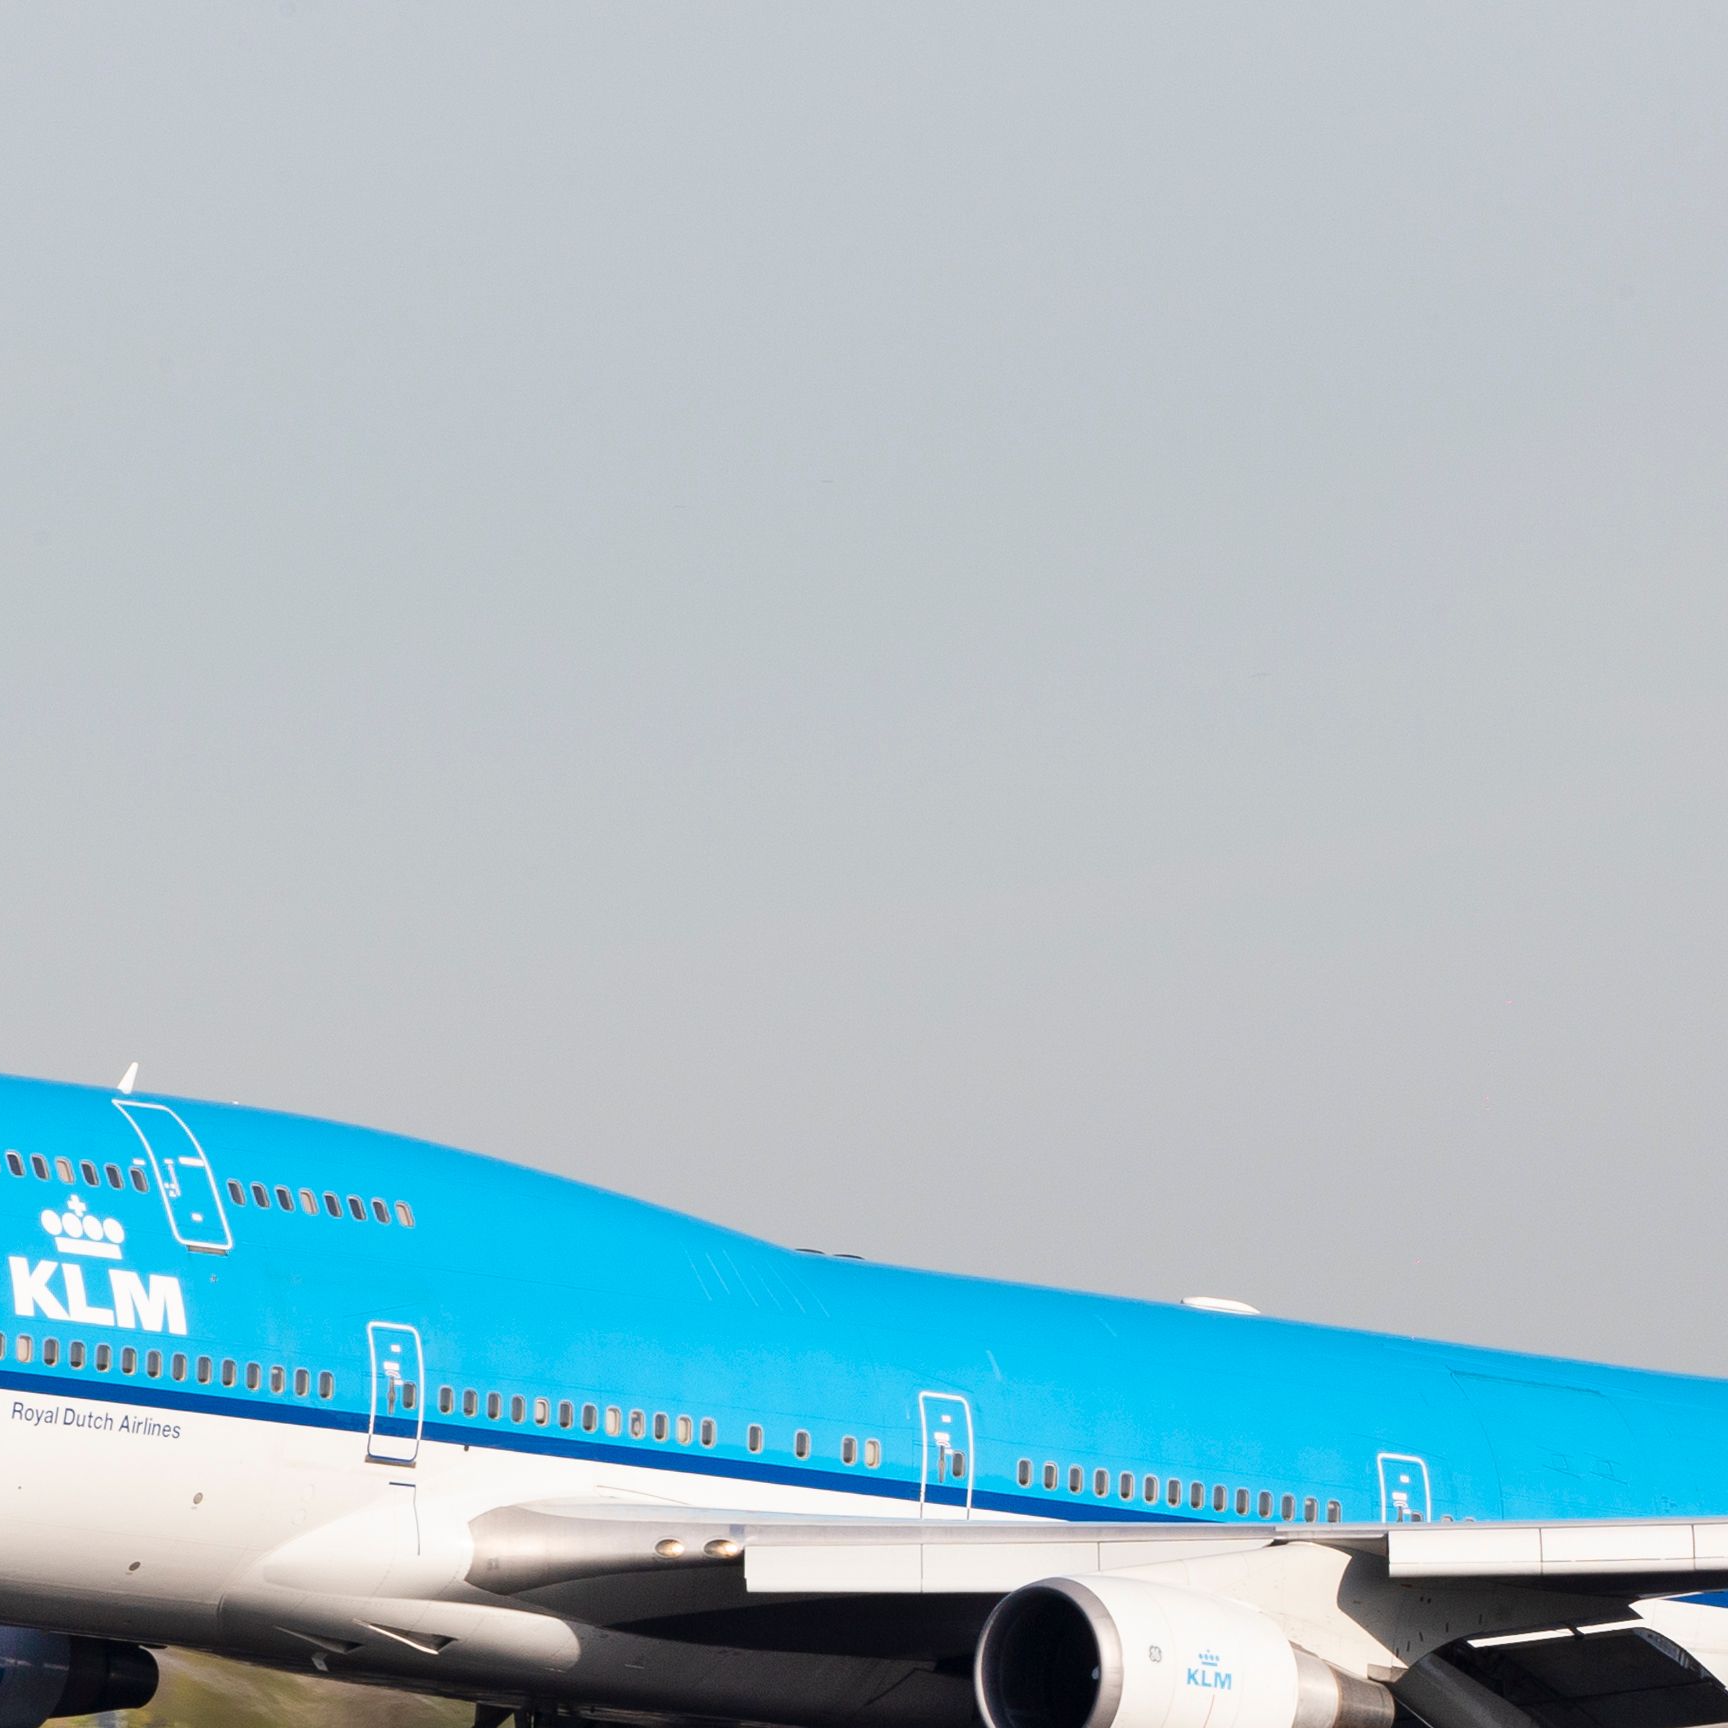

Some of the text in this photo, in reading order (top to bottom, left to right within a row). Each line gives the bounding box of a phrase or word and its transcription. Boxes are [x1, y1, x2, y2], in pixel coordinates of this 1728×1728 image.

[9, 1256, 188, 1336] KLM
[11, 1401, 182, 1440] Royal Dutch Airlines
[1186, 1667, 1233, 1691] KLM
